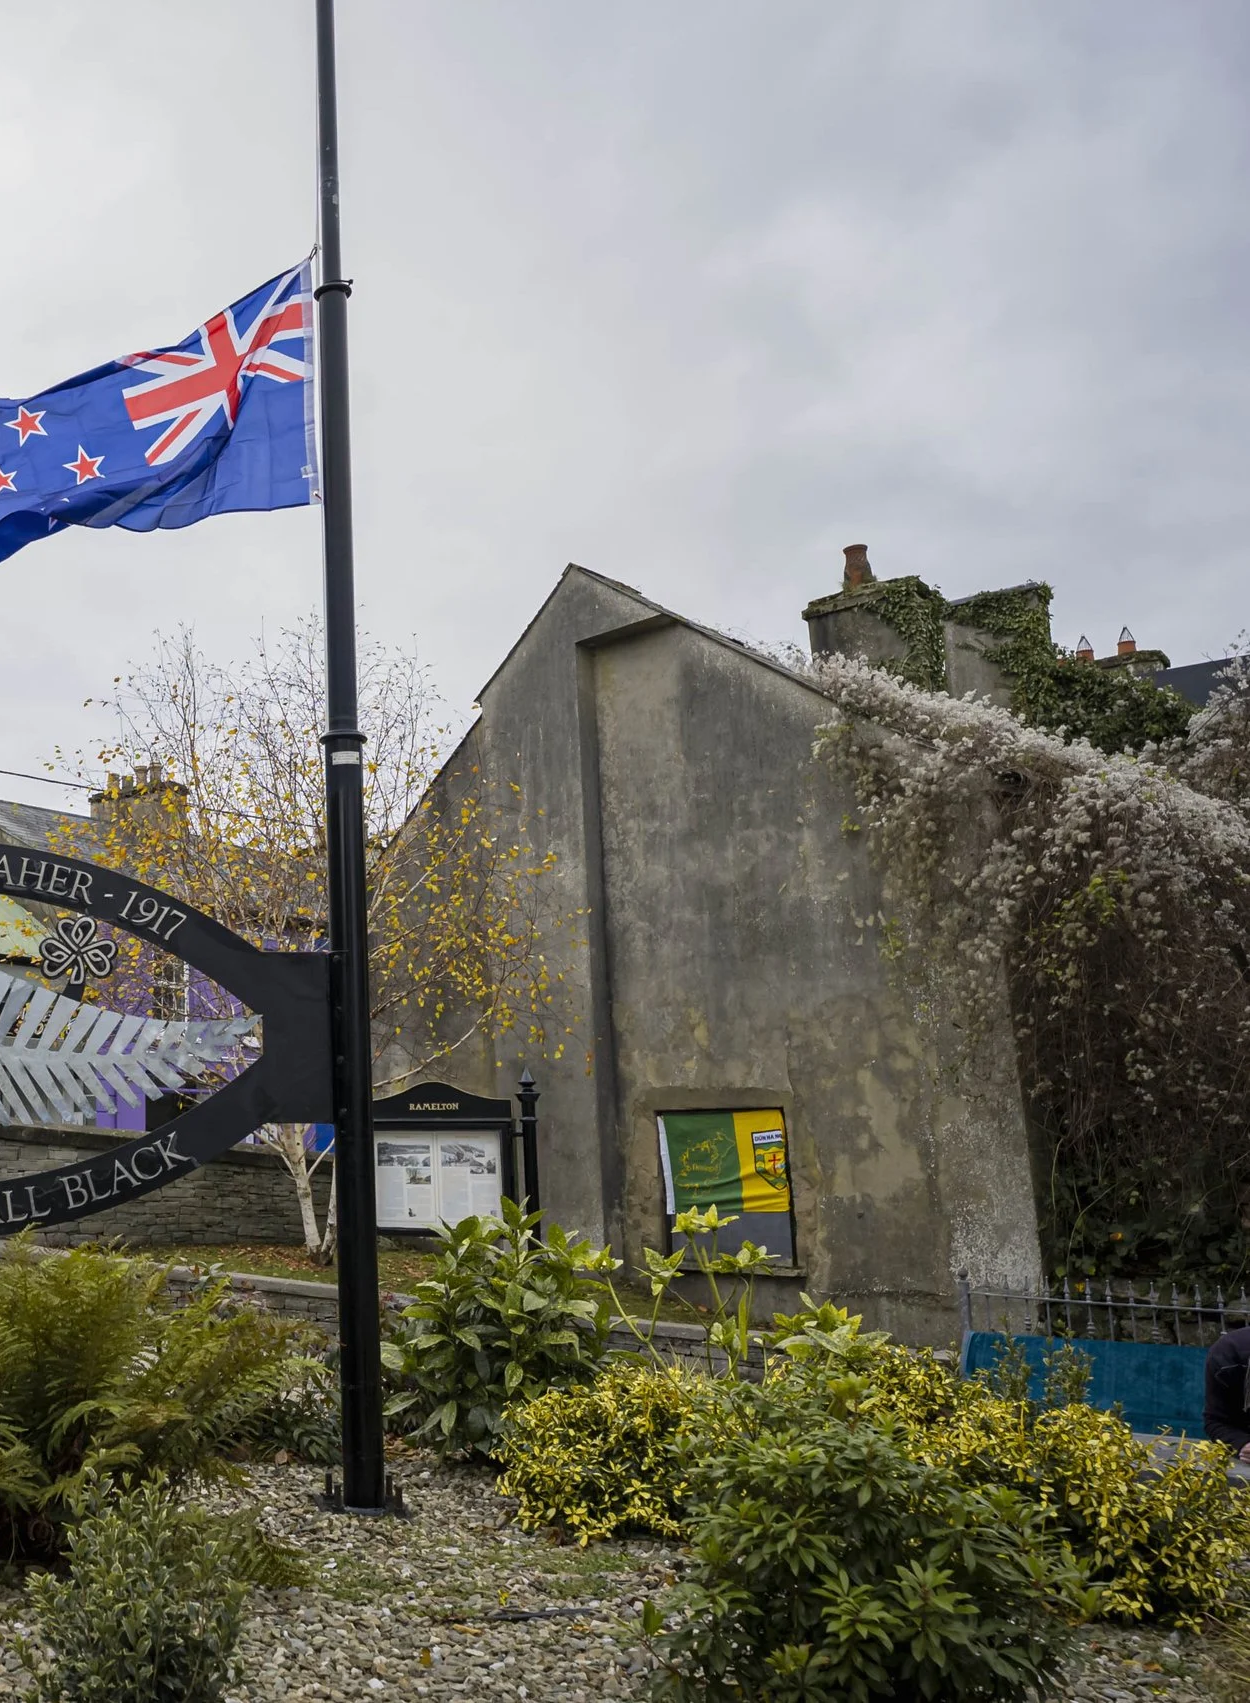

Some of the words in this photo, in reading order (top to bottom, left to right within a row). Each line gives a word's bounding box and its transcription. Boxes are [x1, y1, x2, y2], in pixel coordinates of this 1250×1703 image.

[118, 891, 187, 941] 1917
[409, 1102, 459, 1111] RAMELTON
[59, 1131, 190, 1210] BLACK
